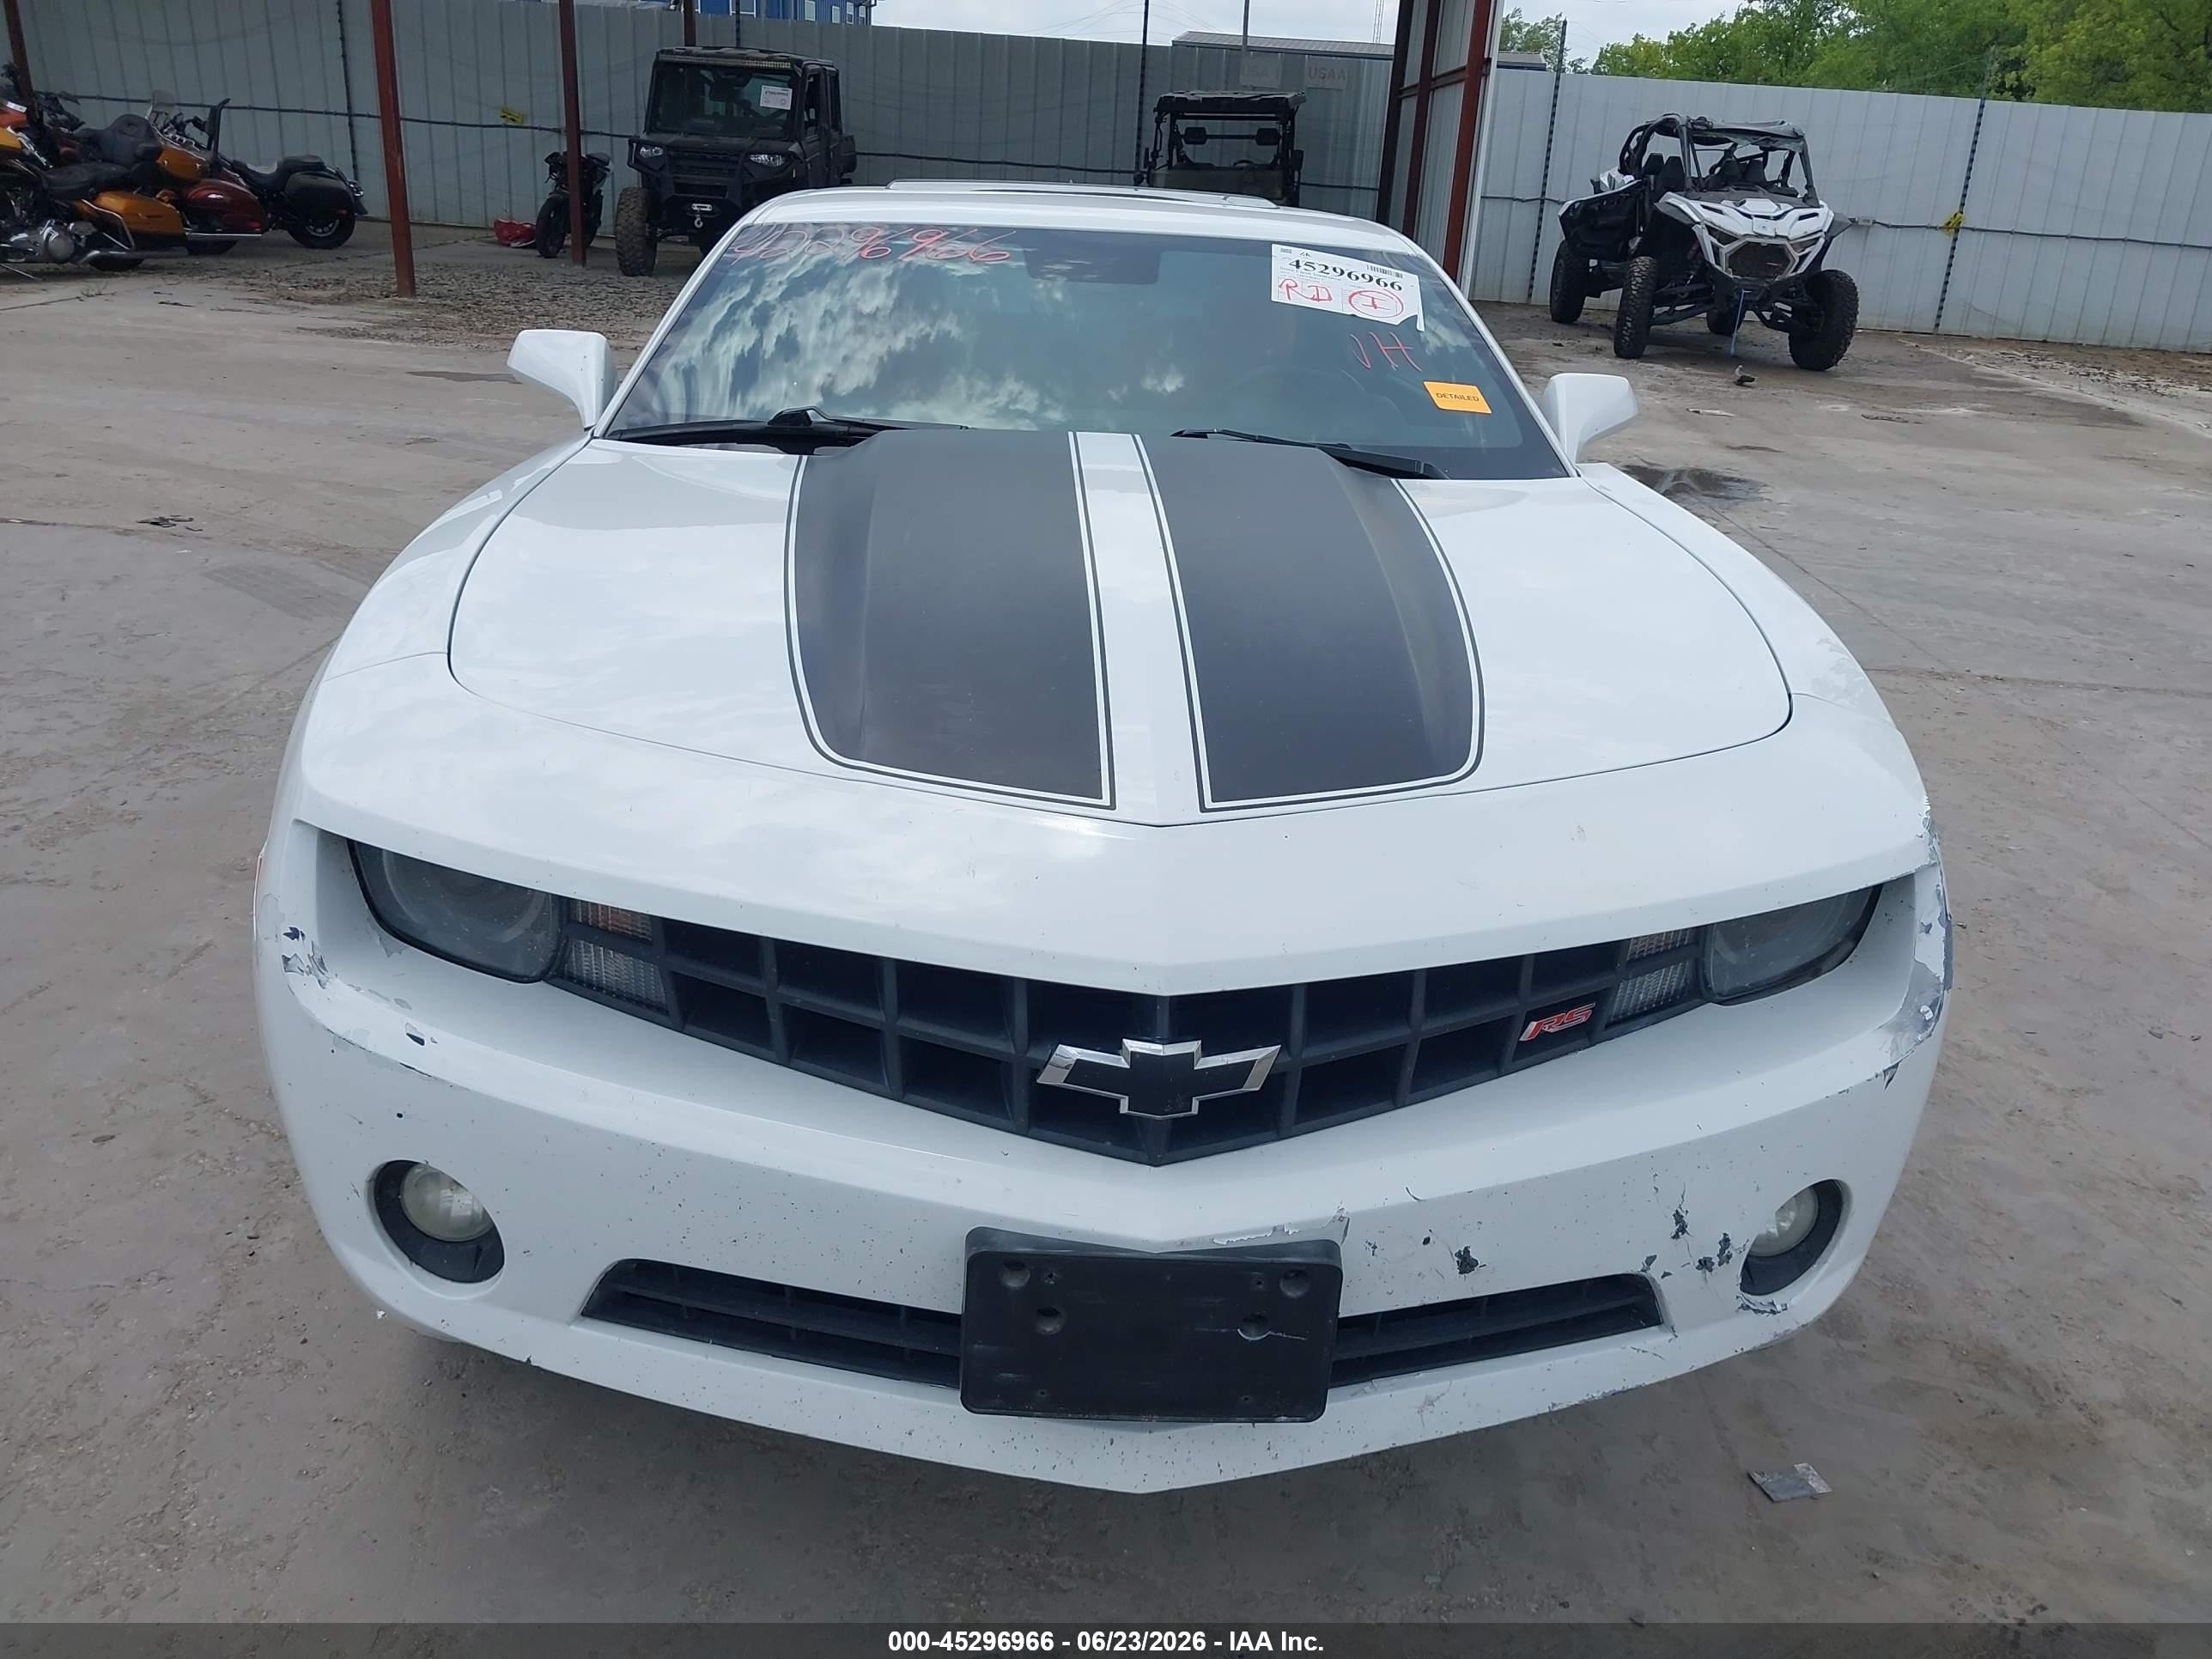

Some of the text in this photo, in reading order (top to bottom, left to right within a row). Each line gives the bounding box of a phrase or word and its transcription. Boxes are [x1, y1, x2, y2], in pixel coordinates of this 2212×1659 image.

[1308, 66, 1346, 81] USAA
[1289, 259, 1402, 291] 45296966
[1436, 392, 1480, 403] DETAILED
[1519, 1003, 1596, 1042] RS
